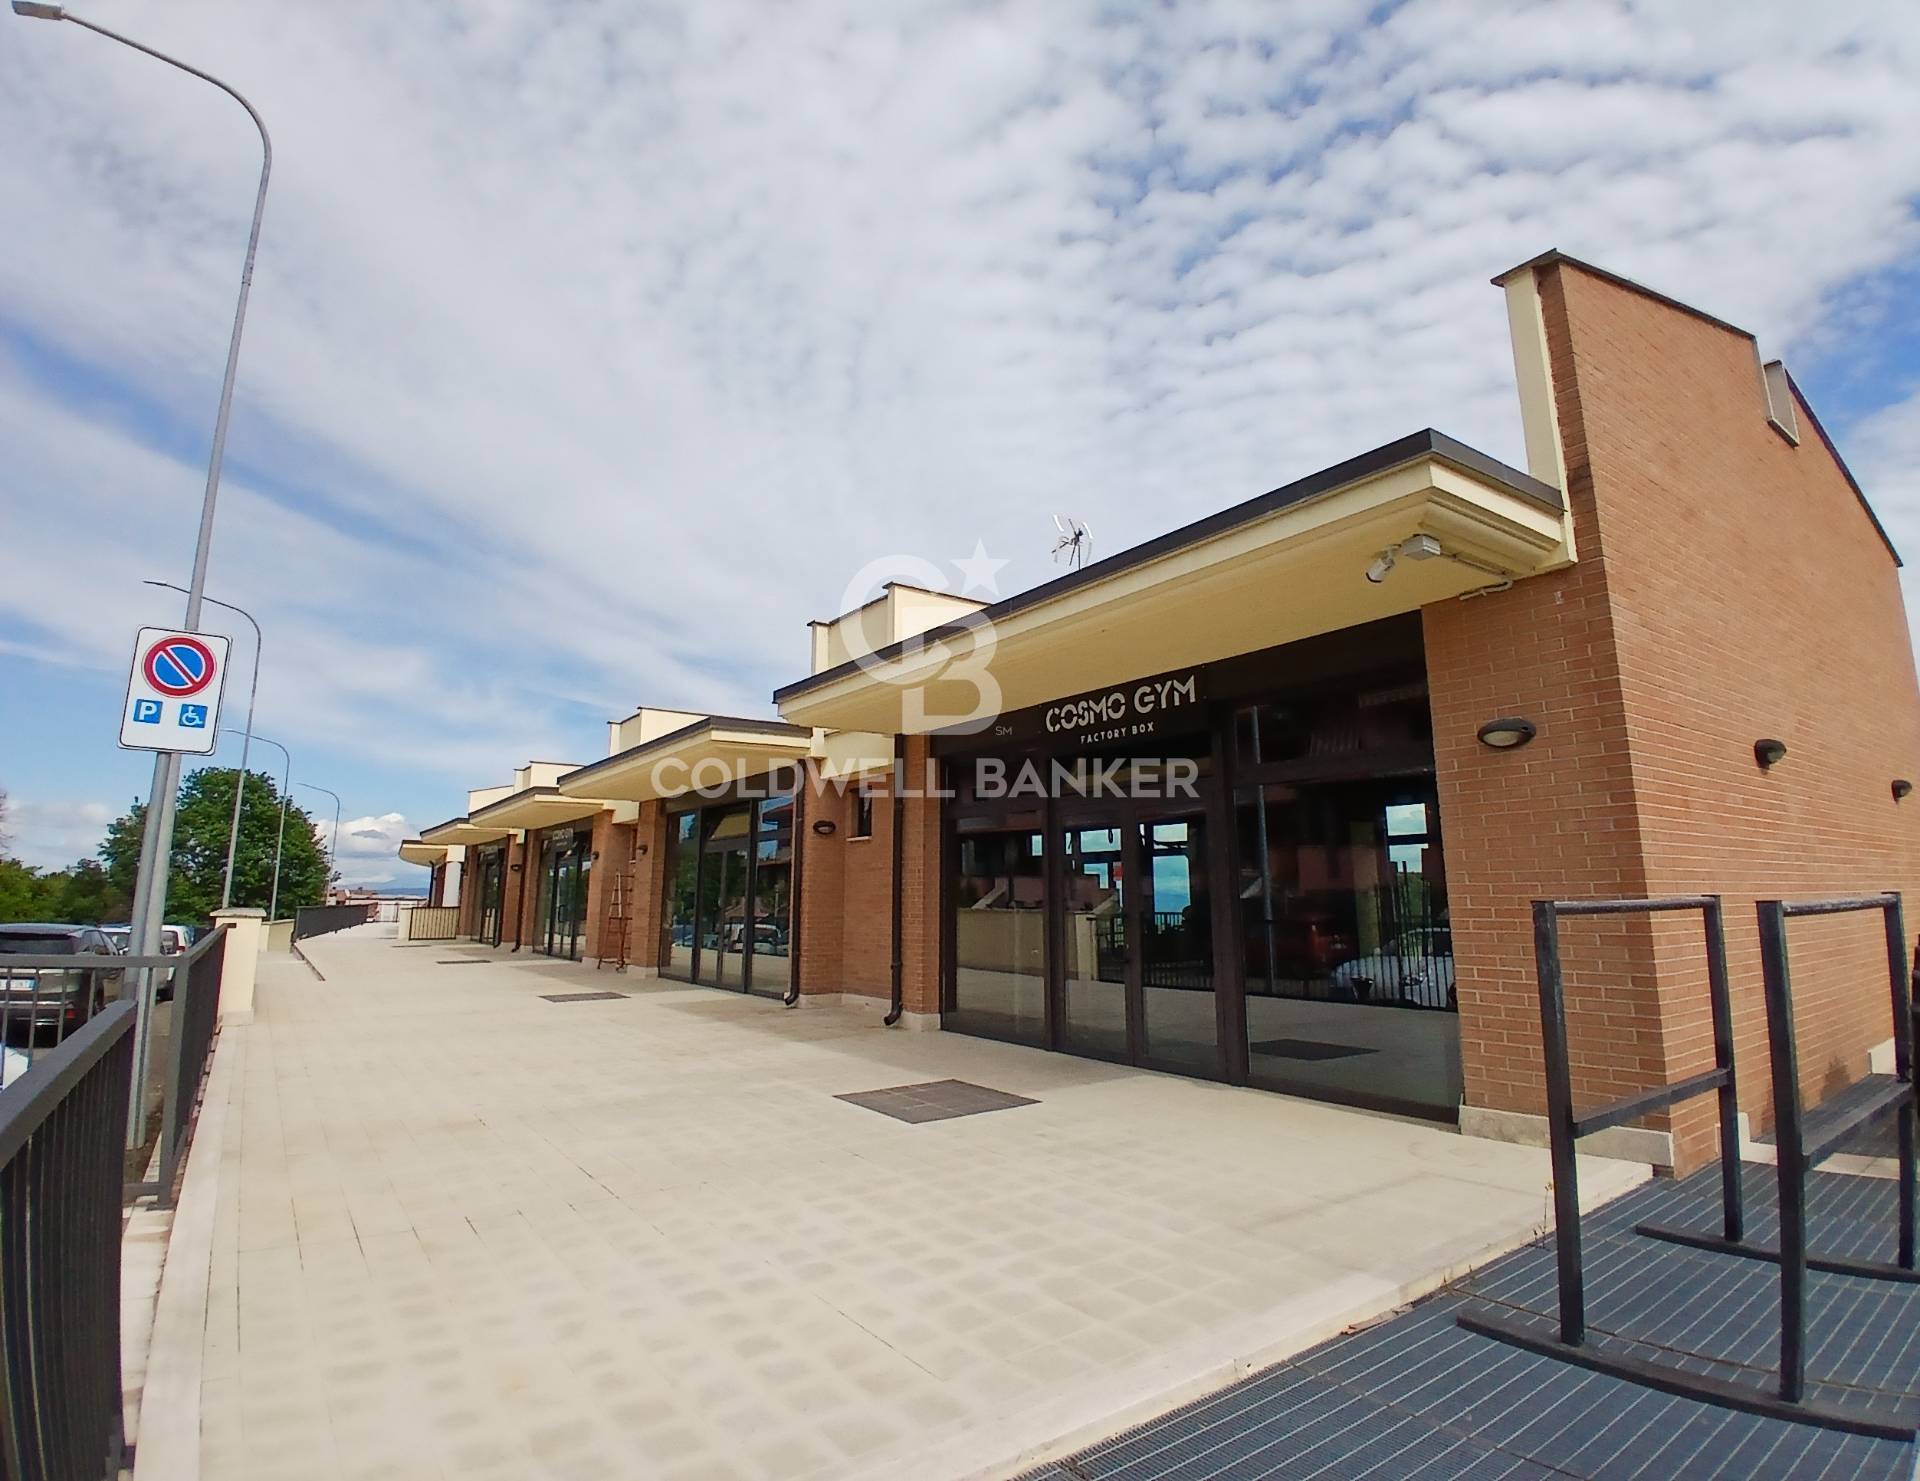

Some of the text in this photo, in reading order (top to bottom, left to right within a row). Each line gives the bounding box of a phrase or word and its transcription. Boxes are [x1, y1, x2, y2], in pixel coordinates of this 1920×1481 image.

[138, 701, 158, 721] P
[1045, 674, 1196, 733] COSMO GYM
[1080, 721, 1155, 744] FACTORY BOX
